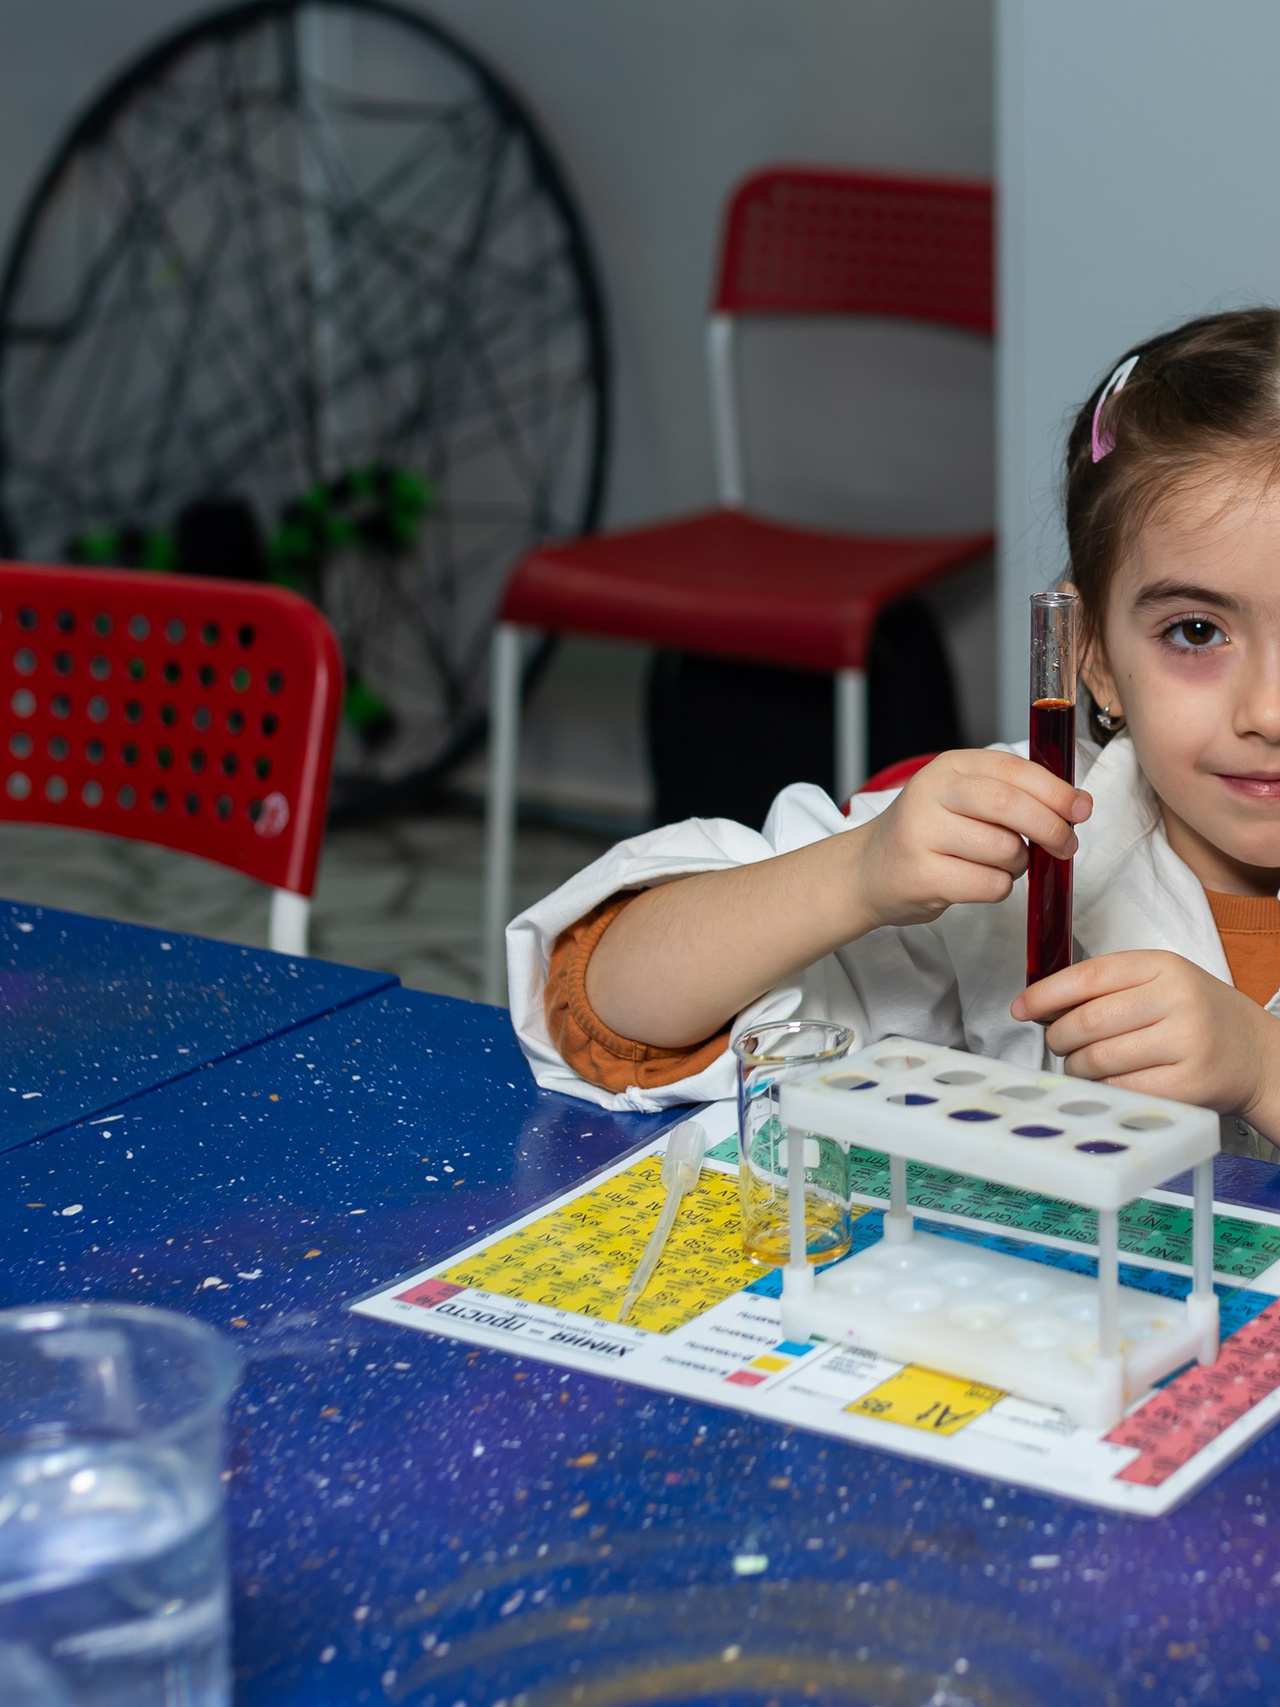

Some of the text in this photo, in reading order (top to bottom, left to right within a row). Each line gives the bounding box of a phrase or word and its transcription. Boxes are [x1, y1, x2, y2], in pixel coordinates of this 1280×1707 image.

[866, 1156, 890, 1168] Fm
[639, 1169, 661, 1182] Og
[906, 1165, 928, 1176] Es
[941, 1174, 964, 1184] Cf
[982, 1182, 1003, 1193] Bk
[605, 1191, 629, 1203] Rn
[716, 1191, 738, 1200] Lv
[909, 1193, 936, 1206] Dy
[1012, 1190, 1042, 1201] Cm
[645, 1201, 663, 1211] At
[951, 1204, 970, 1215] Tb
[1053, 1199, 1078, 1209] Am
[570, 1212, 594, 1223] Xe
[681, 1209, 704, 1220] Po
[985, 1211, 1011, 1223] Gd
[720, 1219, 741, 1229] Bi
[1009, 1218, 1050, 1232] Eu 63
[1137, 1214, 1162, 1228] Np
[537, 1233, 557, 1243] Kr
[1064, 1228, 1092, 1240] Sm
[1221, 1232, 1242, 1244] Pa
[576, 1242, 595, 1252] Br
[683, 1238, 706, 1249] Sb
[1262, 1241, 1280, 1253] Th
[609, 1250, 632, 1260] Se
[721, 1247, 743, 1258] Sn
[1147, 1246, 1172, 1259] Nd
[499, 1254, 520, 1263] Ar
[534, 1262, 556, 1272] Cl
[684, 1267, 709, 1278] Ge
[1232, 1264, 1255, 1275] Ce
[456, 1274, 481, 1285] Ne
[578, 1273, 595, 1283] S
[724, 1276, 748, 1287] Ga
[538, 1294, 557, 1304] O
[655, 1290, 673, 1301] Si
[576, 1304, 597, 1314] N
[692, 1299, 715, 1310] Al
[916, 1403, 972, 1428] At
